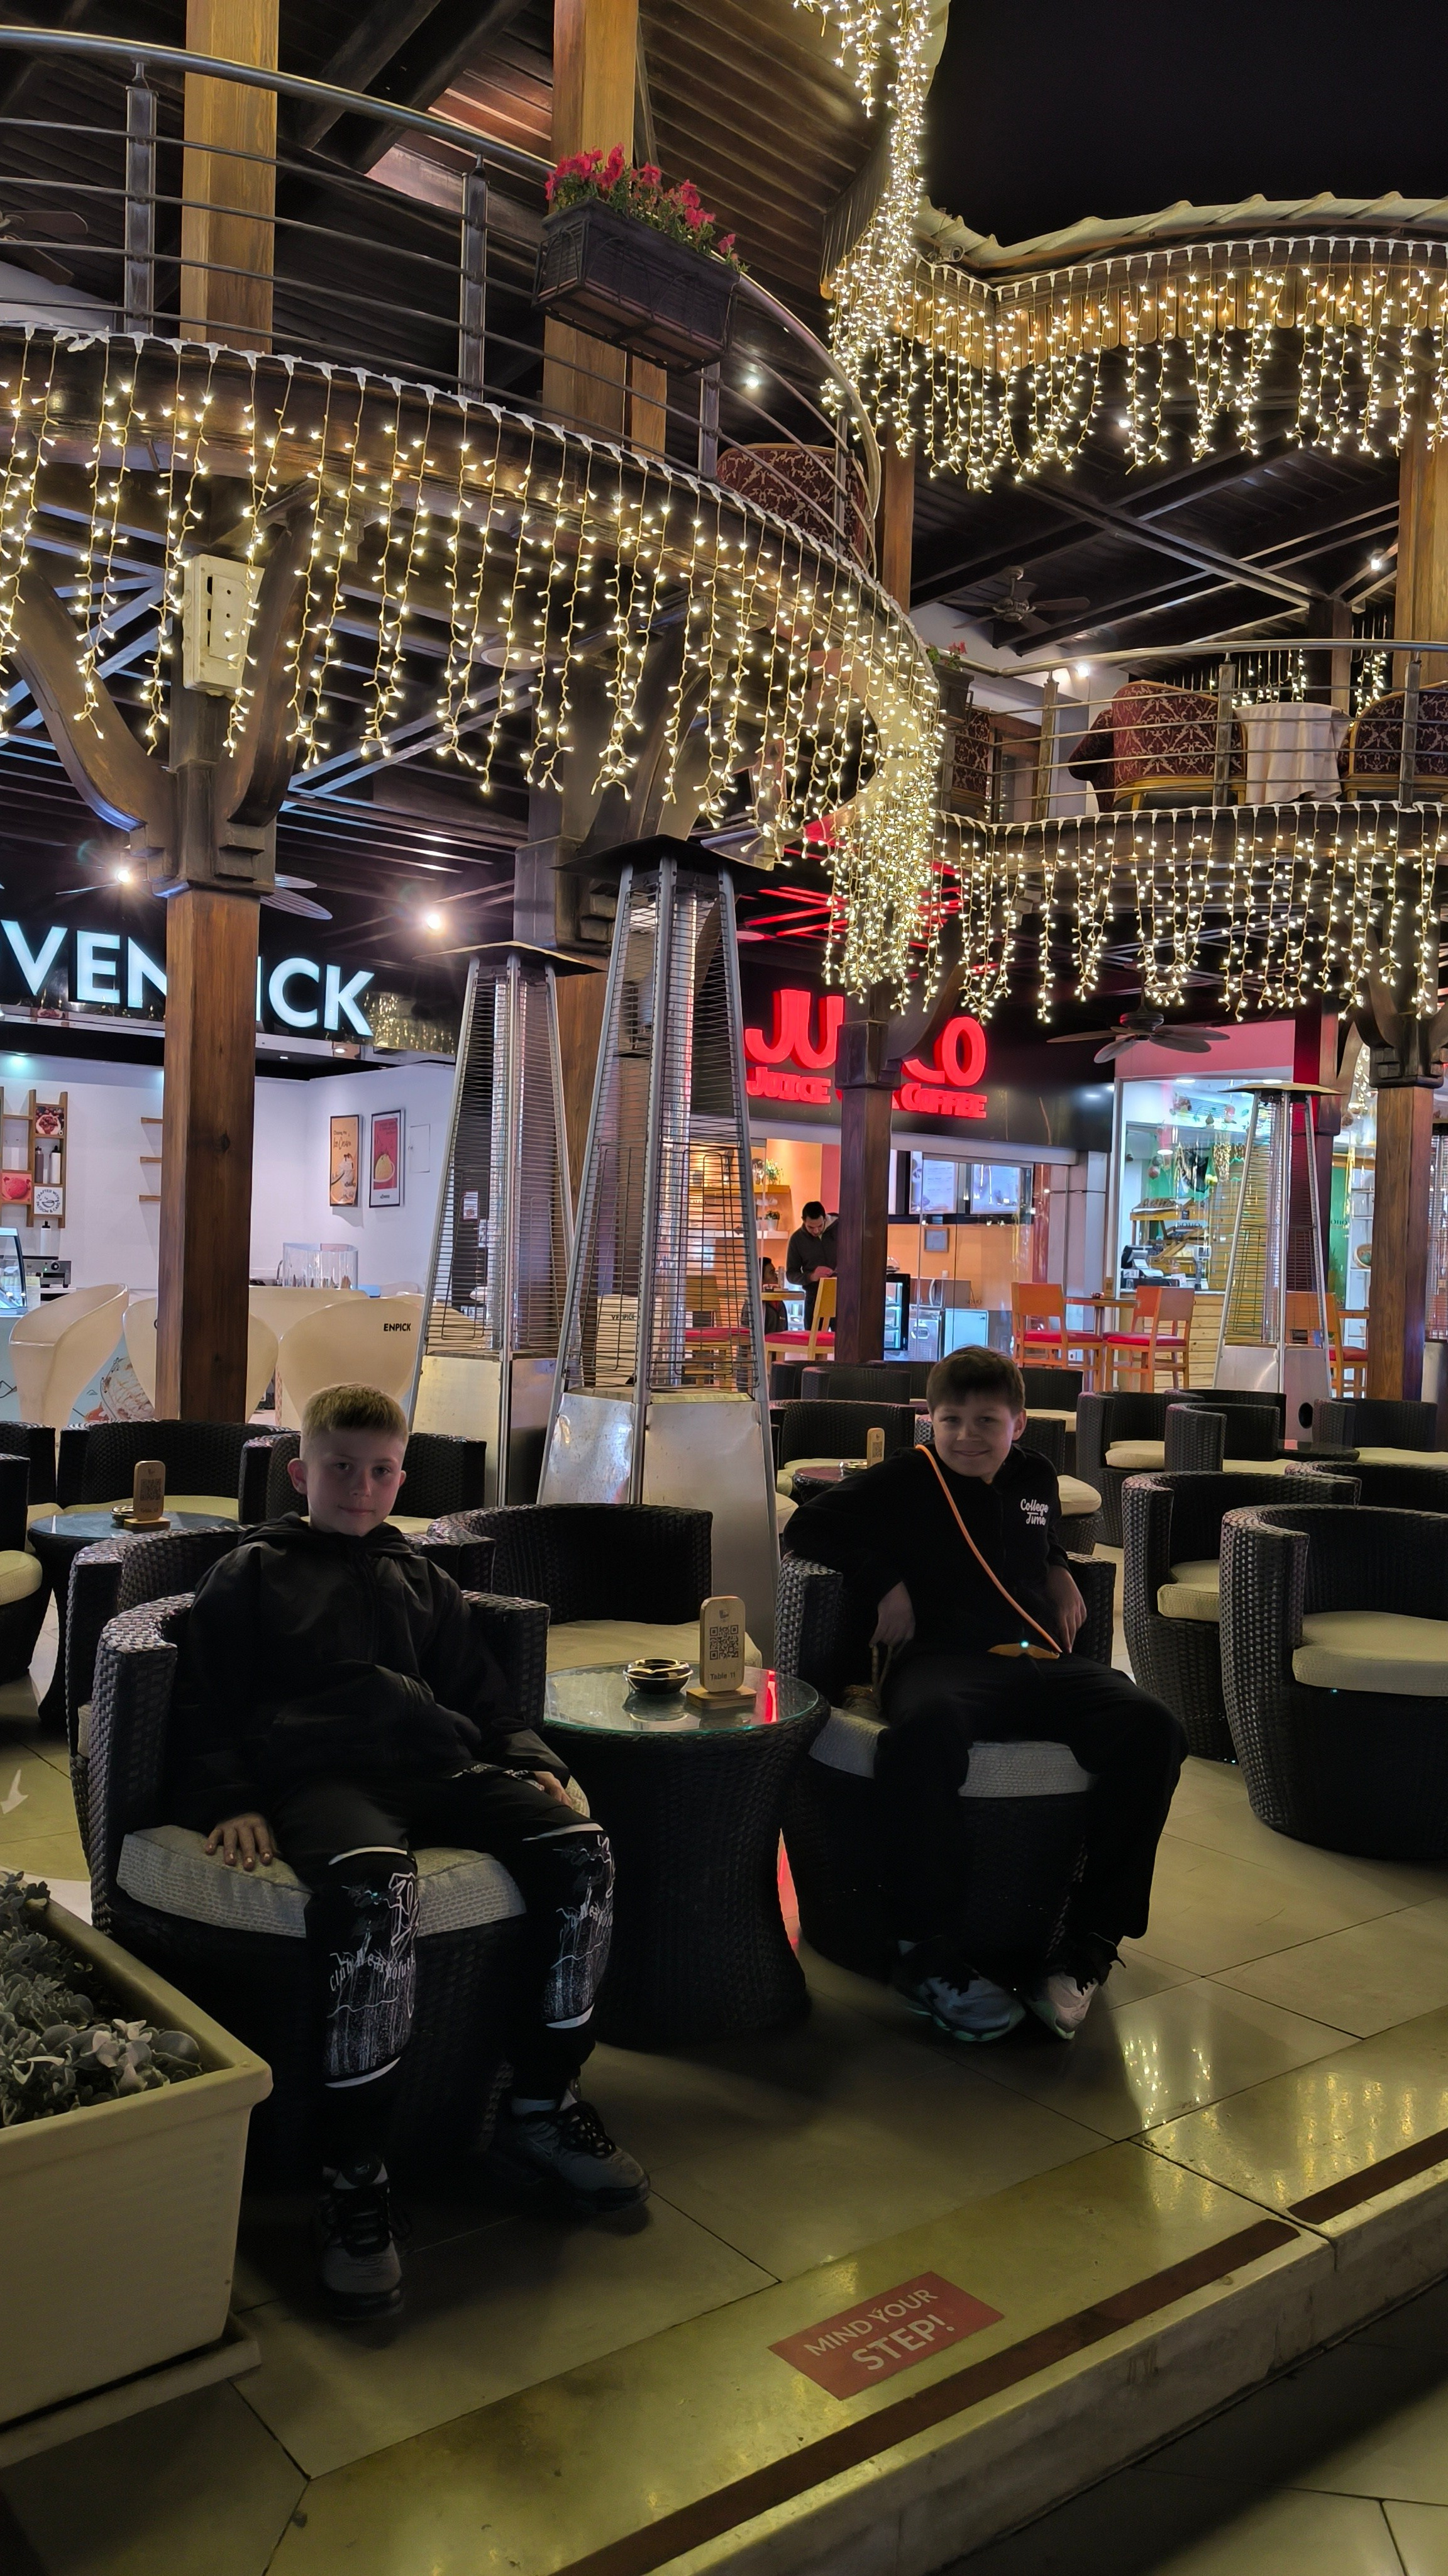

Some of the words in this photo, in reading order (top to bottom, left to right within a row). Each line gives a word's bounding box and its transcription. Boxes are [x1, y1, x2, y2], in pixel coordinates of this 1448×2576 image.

[1, 919, 375, 1036] VENCK
[744, 989, 987, 1087] JUO
[384, 1323, 411, 1331] ENPICK
[1020, 1498, 1049, 1516] College
[1025, 1511, 1047, 1526] Time
[804, 2319, 873, 2356] MIND
[867, 2289, 939, 2324] YOUR
[851, 2314, 955, 2371] STEP!
